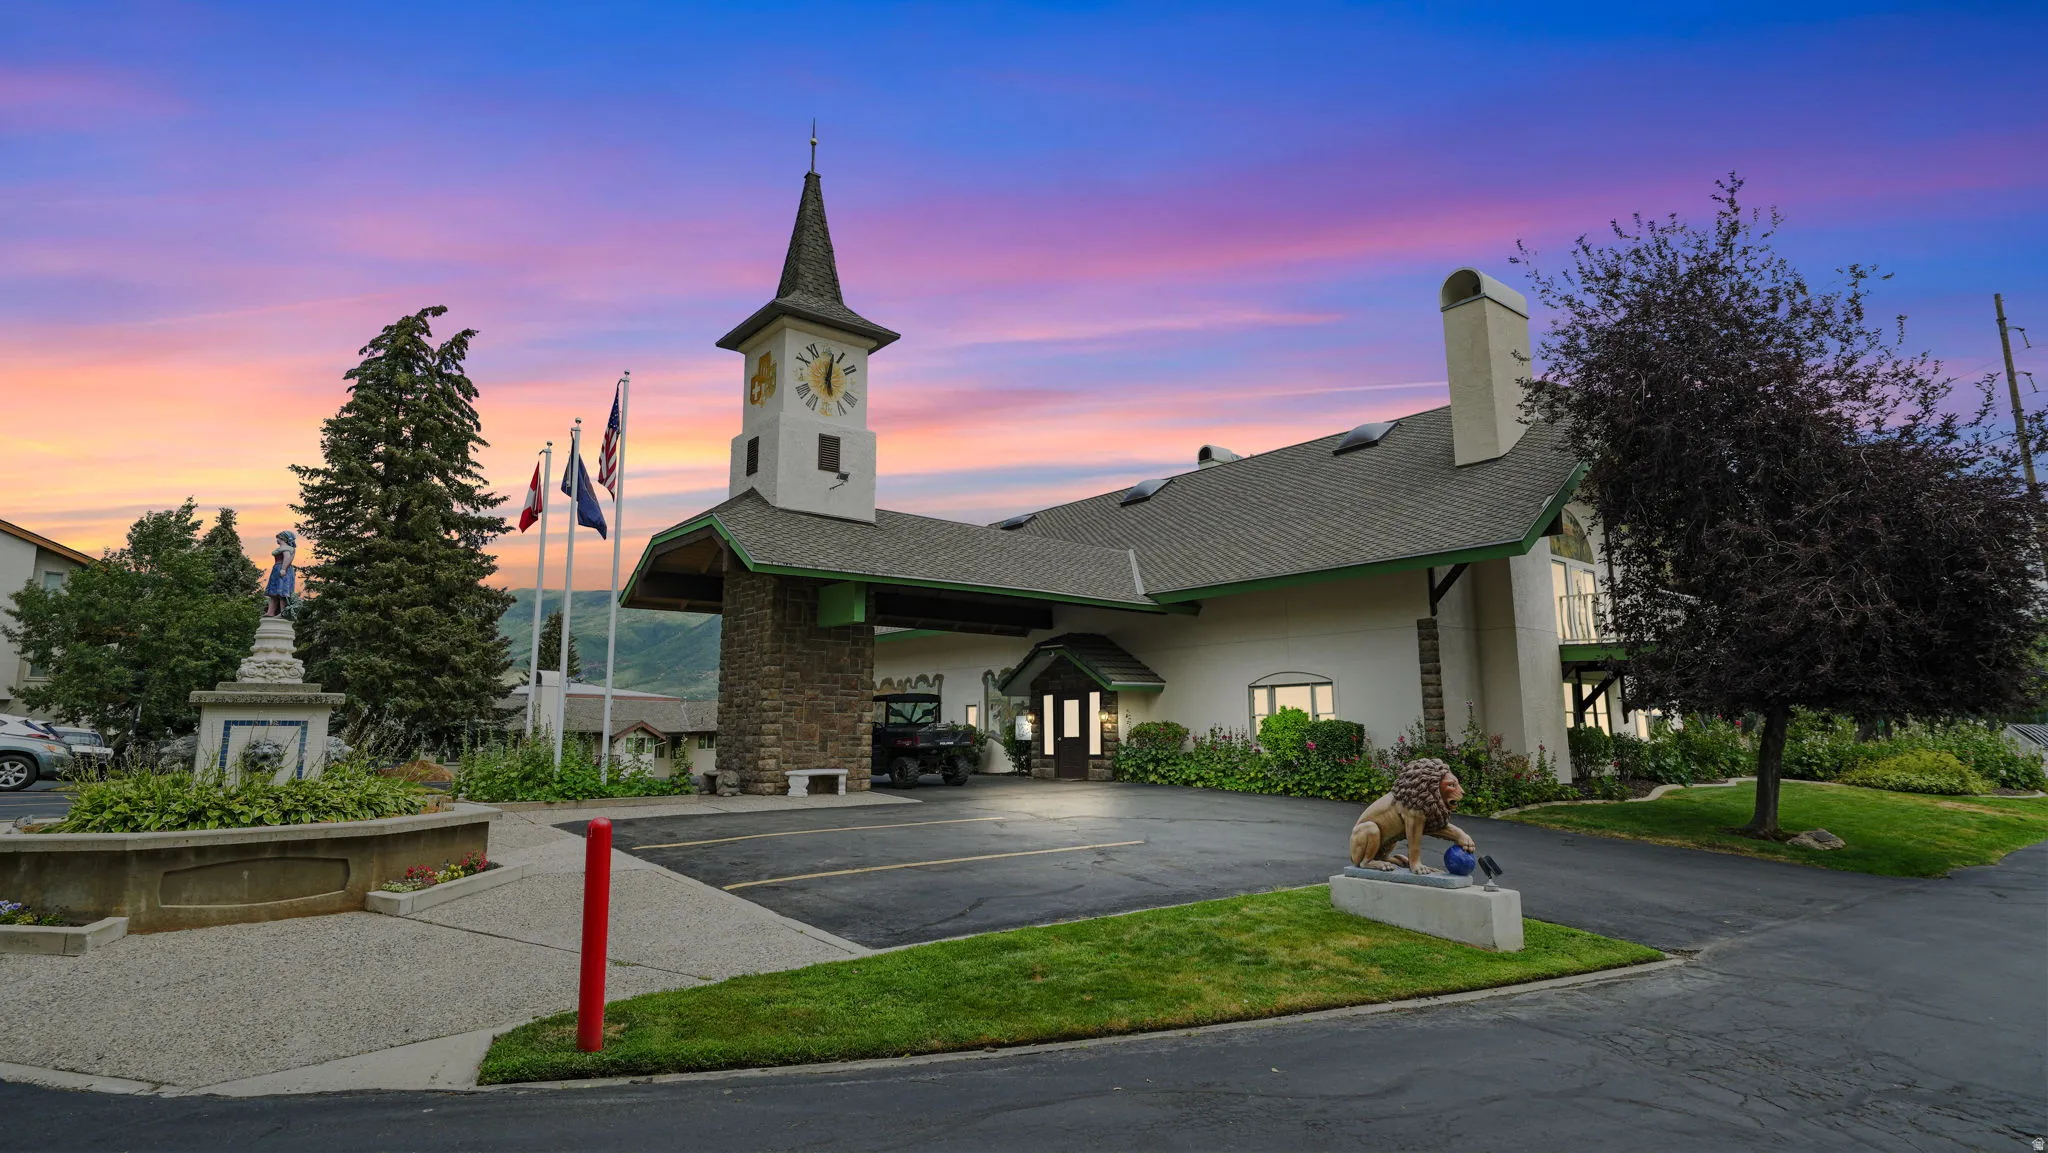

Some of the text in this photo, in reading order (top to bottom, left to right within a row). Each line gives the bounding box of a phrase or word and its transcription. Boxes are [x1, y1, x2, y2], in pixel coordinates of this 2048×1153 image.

[806, 343, 820, 360] XI
[836, 352, 846, 364] I
[795, 352, 811, 367] X
[843, 364, 857, 376] II
[836, 401, 847, 416] V
